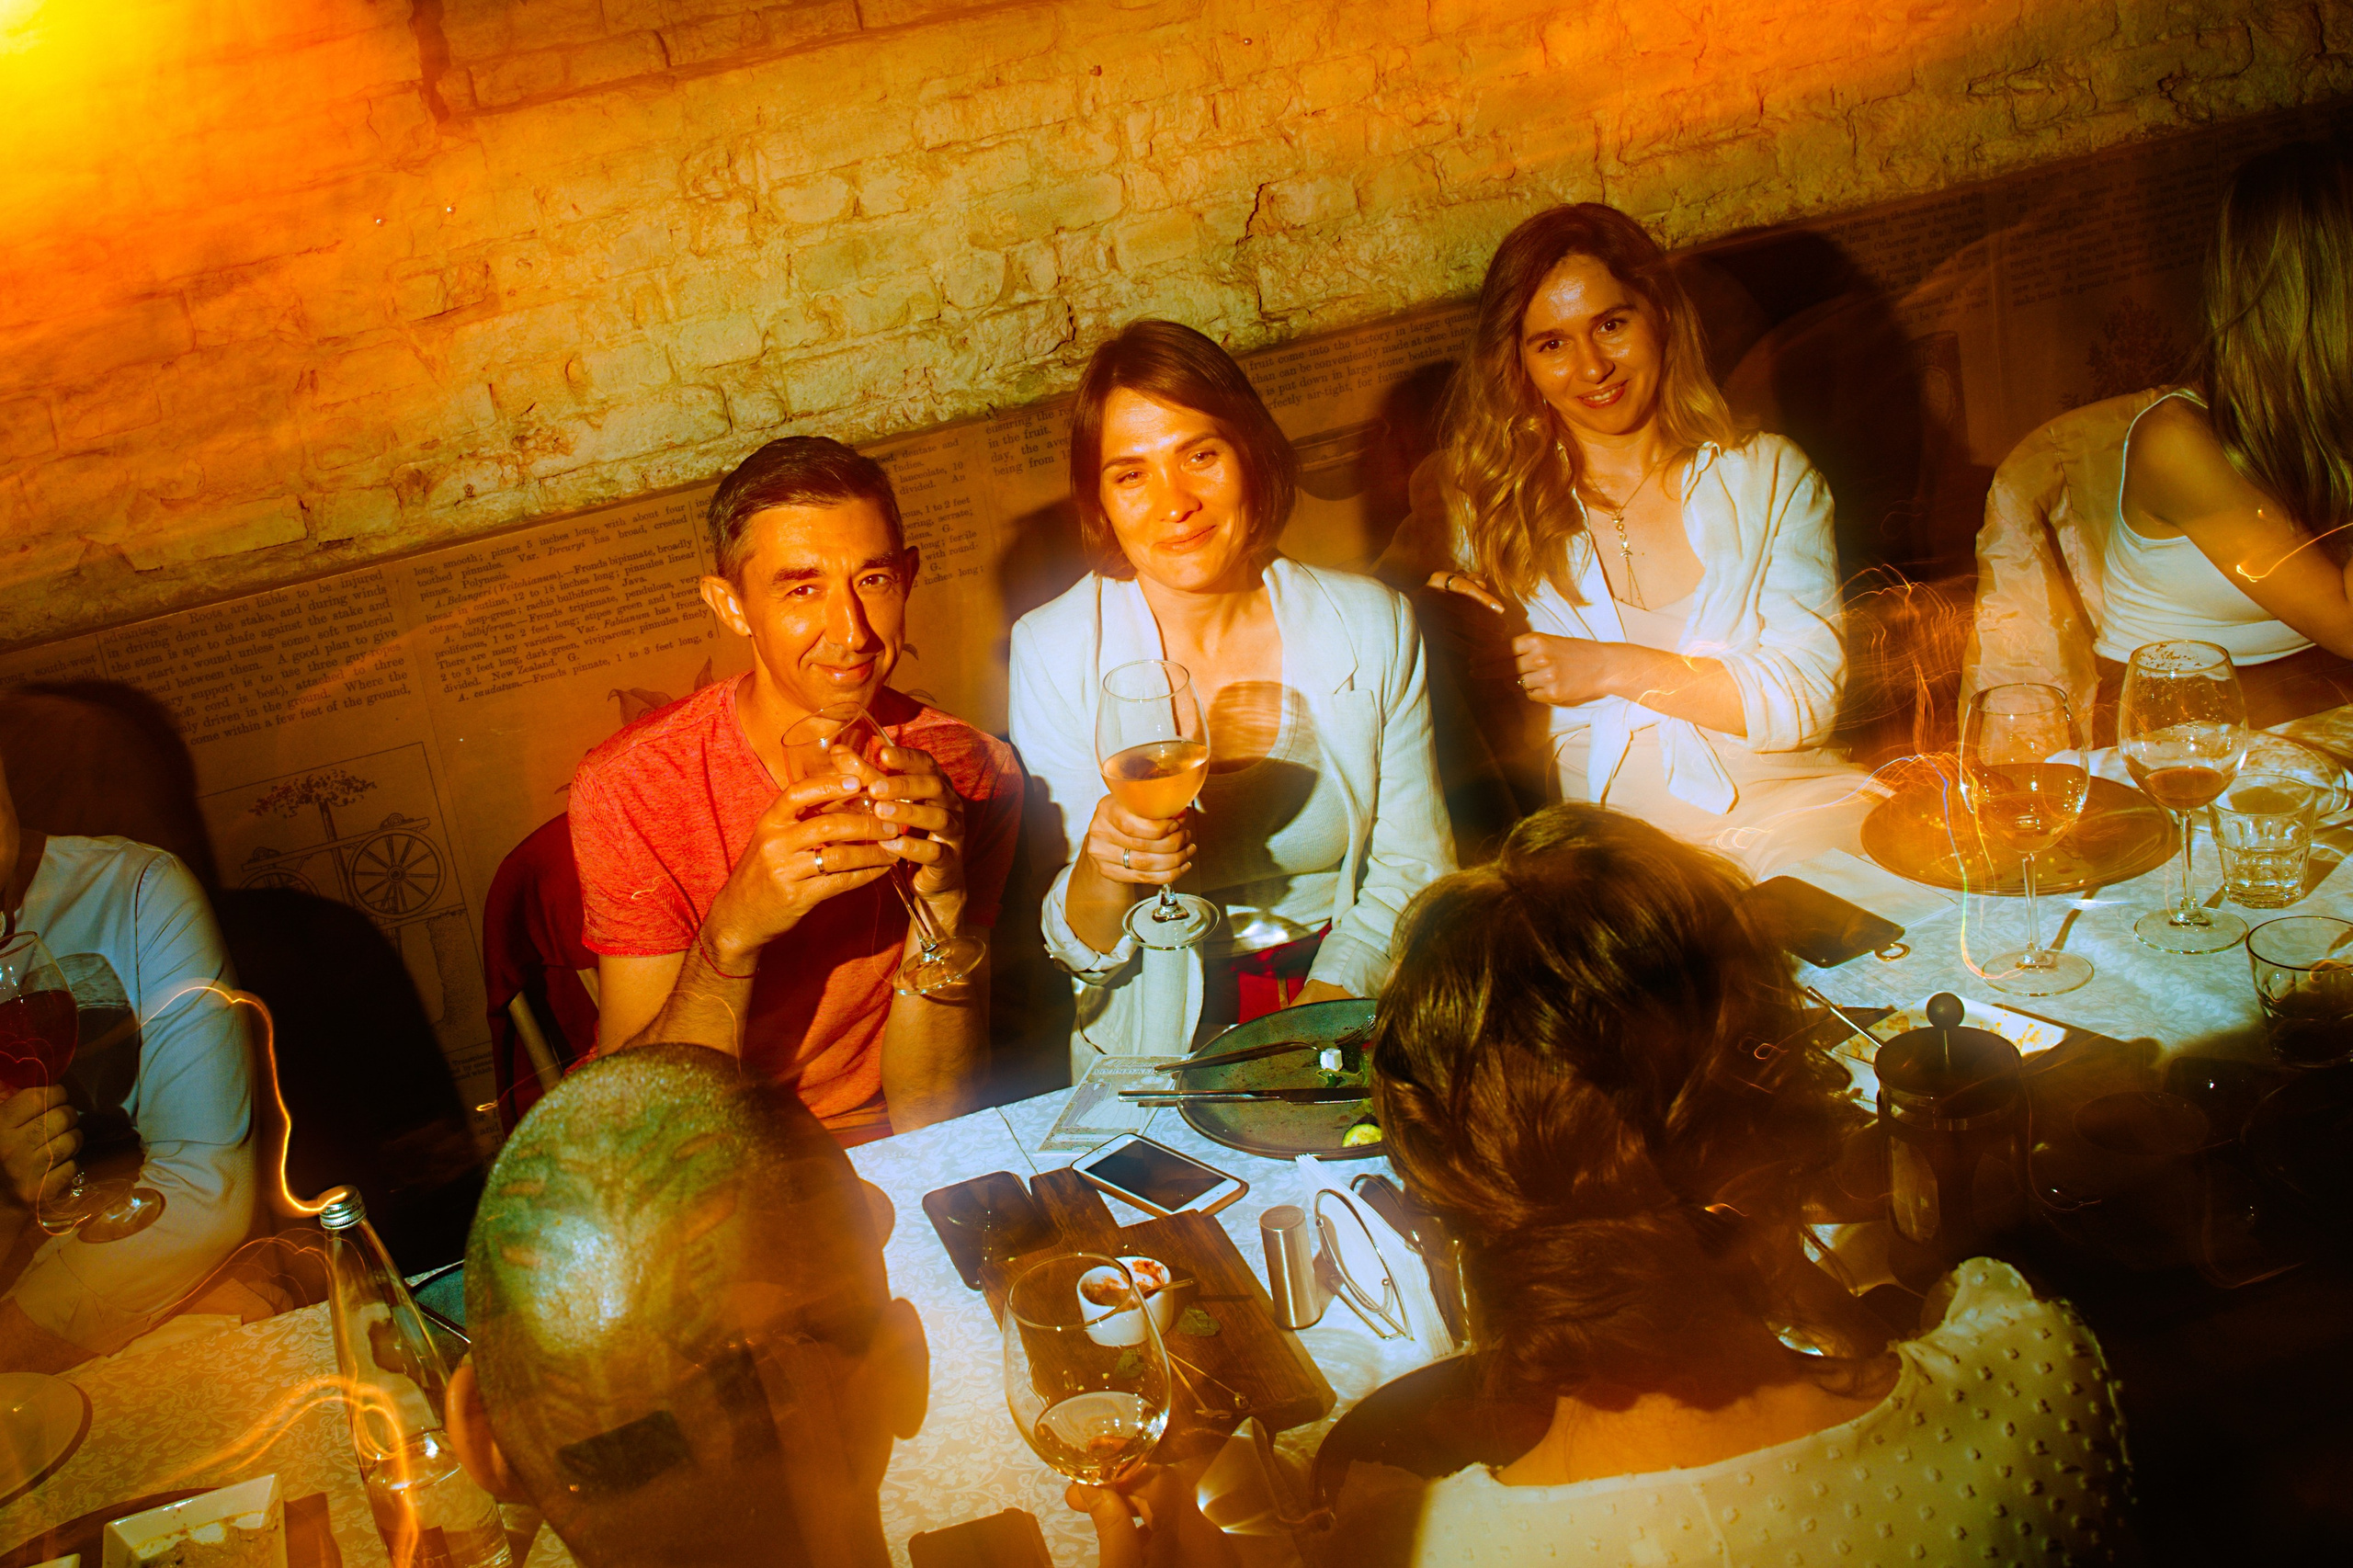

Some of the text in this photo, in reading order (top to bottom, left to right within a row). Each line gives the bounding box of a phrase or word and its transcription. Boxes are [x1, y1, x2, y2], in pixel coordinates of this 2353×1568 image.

[1249, 357, 1275, 370] fruit
[1278, 352, 1304, 364] come
[1334, 339, 1351, 350] the
[1352, 331, 1391, 346] factory
[1395, 326, 1406, 336] in
[1409, 320, 1440, 333] larger
[1266, 339, 1466, 396] is put down in large stone bottles and
[1279, 368, 1297, 378] can
[1298, 363, 1312, 373] be
[1314, 347, 1379, 369] conveniently
[1381, 339, 1409, 354] made
[1411, 337, 1422, 347] at
[1424, 333, 1446, 343] once
[1307, 369, 1411, 400] air-tight, for future
[985, 408, 1054, 435] ensuring the
[988, 426, 1051, 449] in the fruit.
[991, 444, 1039, 463] day, the
[993, 456, 1054, 476] being from
[416, 572, 453, 587] toothed
[460, 558, 505, 580] pinnules.
[517, 553, 539, 562] Var.
[592, 534, 610, 544] has
[618, 525, 648, 539] broad,
[654, 514, 688, 529] crested
[526, 540, 533, 549] 5
[539, 533, 569, 546] inches
[604, 517, 626, 529] with
[632, 510, 659, 523] about
[665, 505, 685, 515] four
[104, 569, 383, 647] advantages. Roots are liable to be injured
[425, 611, 452, 623] linear
[457, 606, 468, 615] in
[473, 597, 510, 611] outline,
[513, 592, 525, 602] 12
[543, 584, 555, 594] 18
[559, 577, 590, 590] inches
[624, 559, 665, 576] pinnules
[667, 551, 696, 563] linear
[428, 622, 462, 635] obtuse,
[526, 597, 554, 611] rachis
[556, 585, 612, 603] bulbiferous.
[622, 576, 647, 587] Java.
[461, 572, 510, 589] Polynesia.
[107, 585, 387, 659] in driving down the stake, and during winds
[111, 597, 392, 673] the stem is apt to chafe against the stake and
[147, 665, 176, 680] start
[193, 650, 233, 668] wound
[238, 643, 275, 658] unless
[281, 635, 311, 648] some
[317, 625, 340, 640] soft
[346, 611, 394, 633] material
[440, 674, 447, 682] 2
[451, 671, 461, 679] to
[465, 666, 472, 676] 3
[476, 662, 494, 673] feet
[526, 642, 580, 660] dark-green,
[584, 628, 635, 645] viviparous;
[639, 617, 679, 634] pinnules
[682, 608, 708, 621] finely
[176, 629, 398, 688] between them. A good plan to give
[191, 733, 220, 744] come
[223, 722, 261, 737] within
[275, 713, 296, 725] few
[300, 706, 323, 720] feet
[326, 700, 338, 712] of
[343, 697, 362, 709] the
[366, 683, 411, 706] ground,
